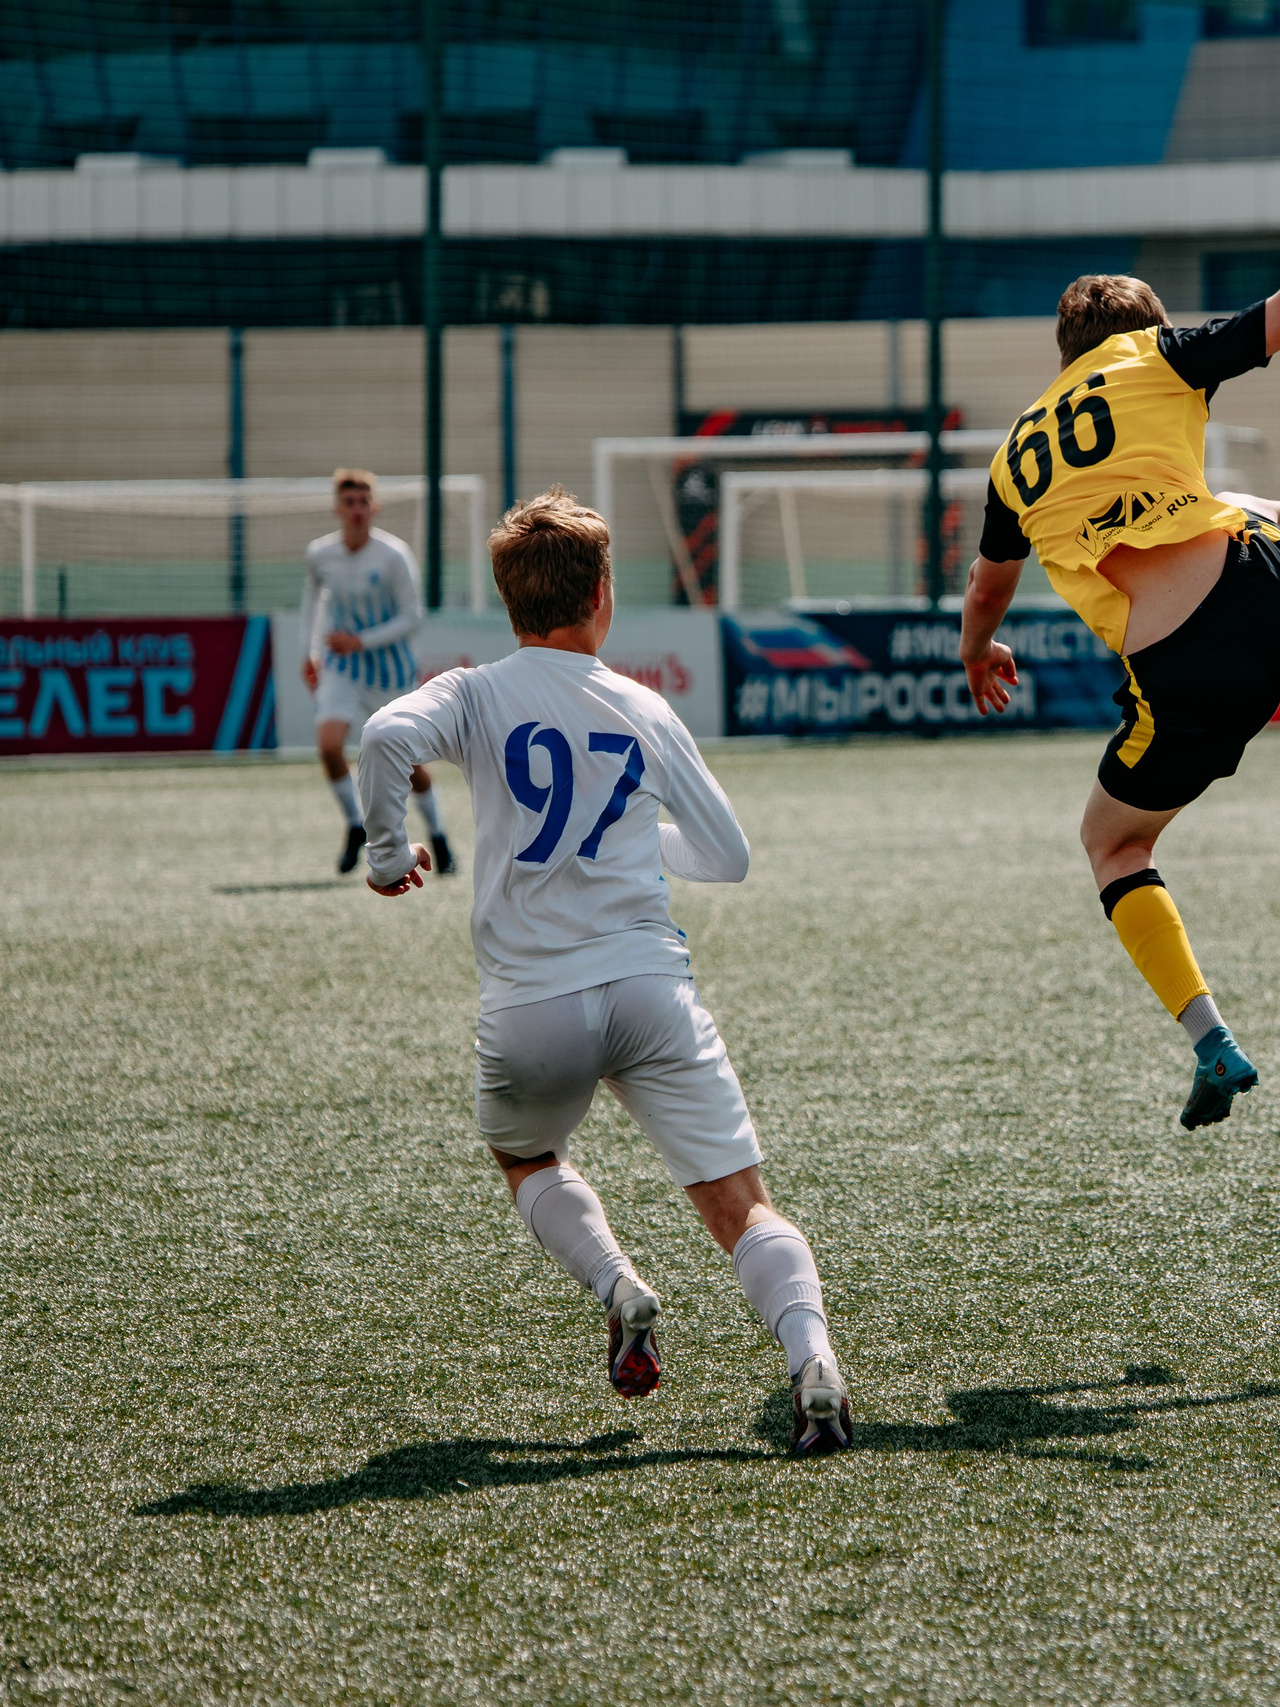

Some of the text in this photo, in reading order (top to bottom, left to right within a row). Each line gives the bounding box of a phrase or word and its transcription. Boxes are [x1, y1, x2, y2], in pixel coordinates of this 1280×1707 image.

[1007, 372, 1116, 507] 66
[1166, 492, 1199, 517] RUS
[118, 632, 195, 666] КЛУБ
[890, 619, 1117, 661] #МЫМЕСТ
[736, 671, 1037, 724] #МЫРОССЯ
[504, 721, 646, 864] 97
